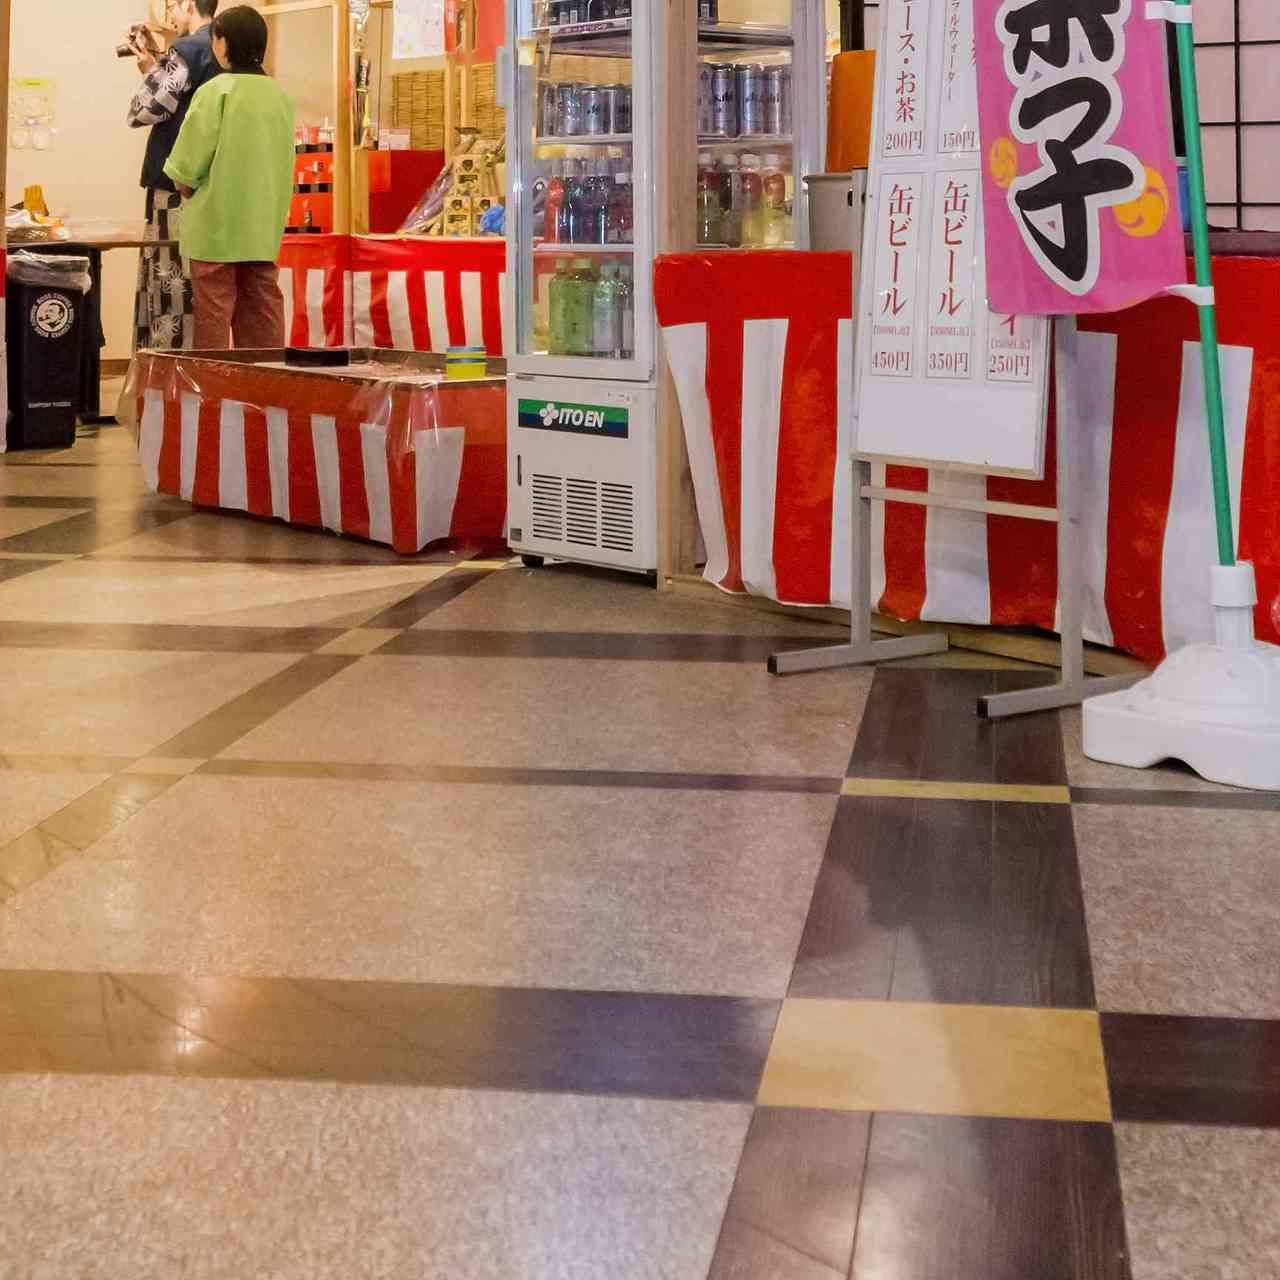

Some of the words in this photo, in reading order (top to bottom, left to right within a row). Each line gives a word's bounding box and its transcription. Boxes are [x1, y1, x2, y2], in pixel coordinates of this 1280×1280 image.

[885, 130, 923, 151] 200円
[942, 130, 976, 150] 150円
[881, 183, 914, 316] 缶ビール
[937, 180, 970, 316] 缶ビール
[872, 351, 910, 371] 450円
[928, 351, 969, 373] 350円
[989, 355, 1030, 377] 250円
